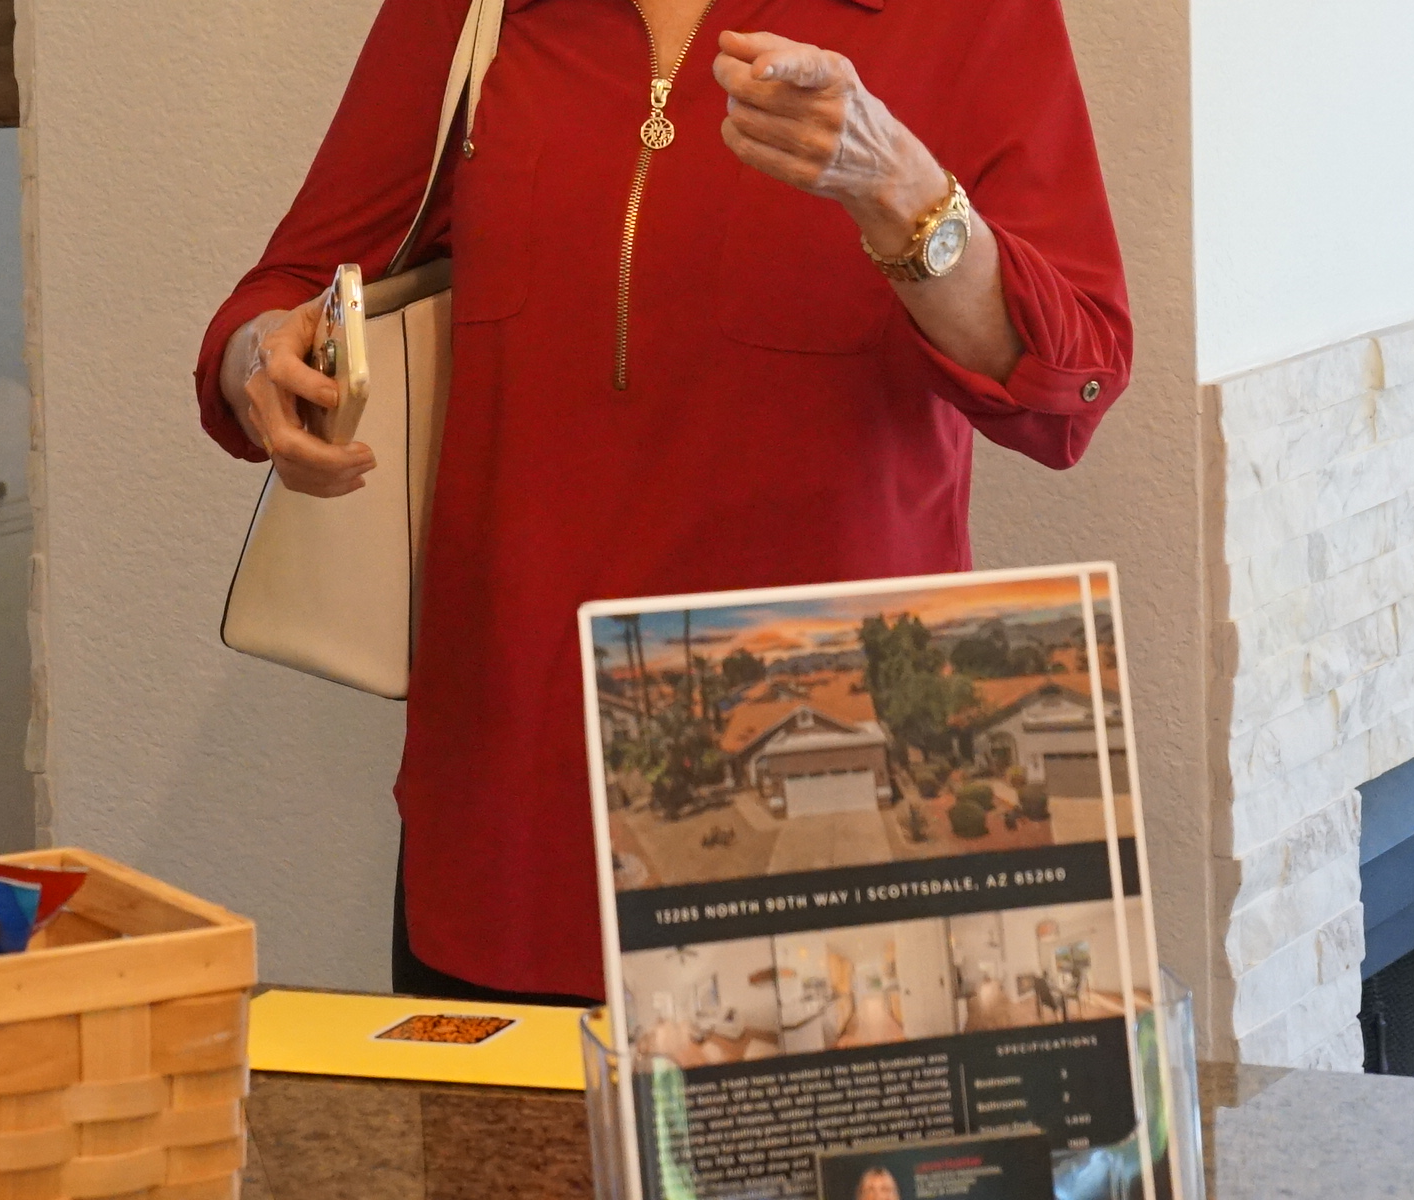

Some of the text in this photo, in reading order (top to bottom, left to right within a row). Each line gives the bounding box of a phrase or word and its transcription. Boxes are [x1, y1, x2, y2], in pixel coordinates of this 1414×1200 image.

[704, 900, 760, 919] NORTH
[765, 893, 807, 913] 90TH
[812, 889, 849, 907] WAY
[866, 876, 980, 902] SCOTTSDALE,
[986, 872, 1008, 889] AZ
[1014, 867, 1066, 885] 85260
[996, 1035, 1098, 1056] SPECIFICATIONS
[850, 1060, 877, 1073] North
[878, 1054, 925, 1070] Scottsdale
